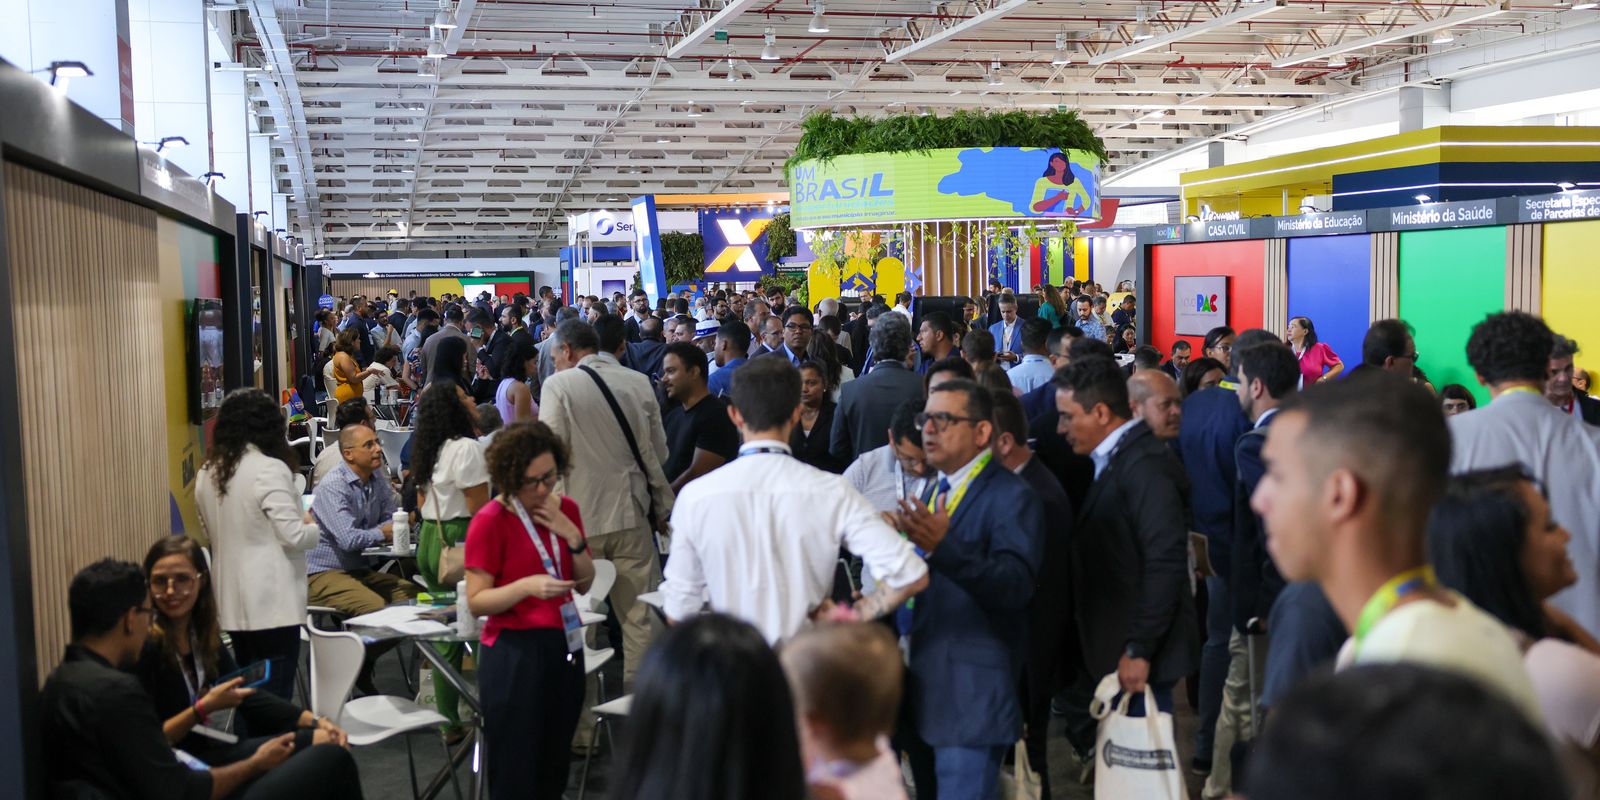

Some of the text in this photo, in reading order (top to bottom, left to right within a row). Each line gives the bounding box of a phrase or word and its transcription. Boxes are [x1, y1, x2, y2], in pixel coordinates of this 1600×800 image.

[795, 166, 815, 181] UM
[795, 173, 894, 203] BRASIL
[1525, 195, 1571, 210] Secretaria
[1392, 205, 1493, 225] Ministério da Saúde
[1531, 205, 1600, 220] de Parcerias de
[1208, 223, 1246, 237] CASA CIVIL
[1277, 215, 1363, 231] Ministério da Educação
[1167, 226, 1180, 239] PAC
[1197, 294, 1217, 312] PAC
